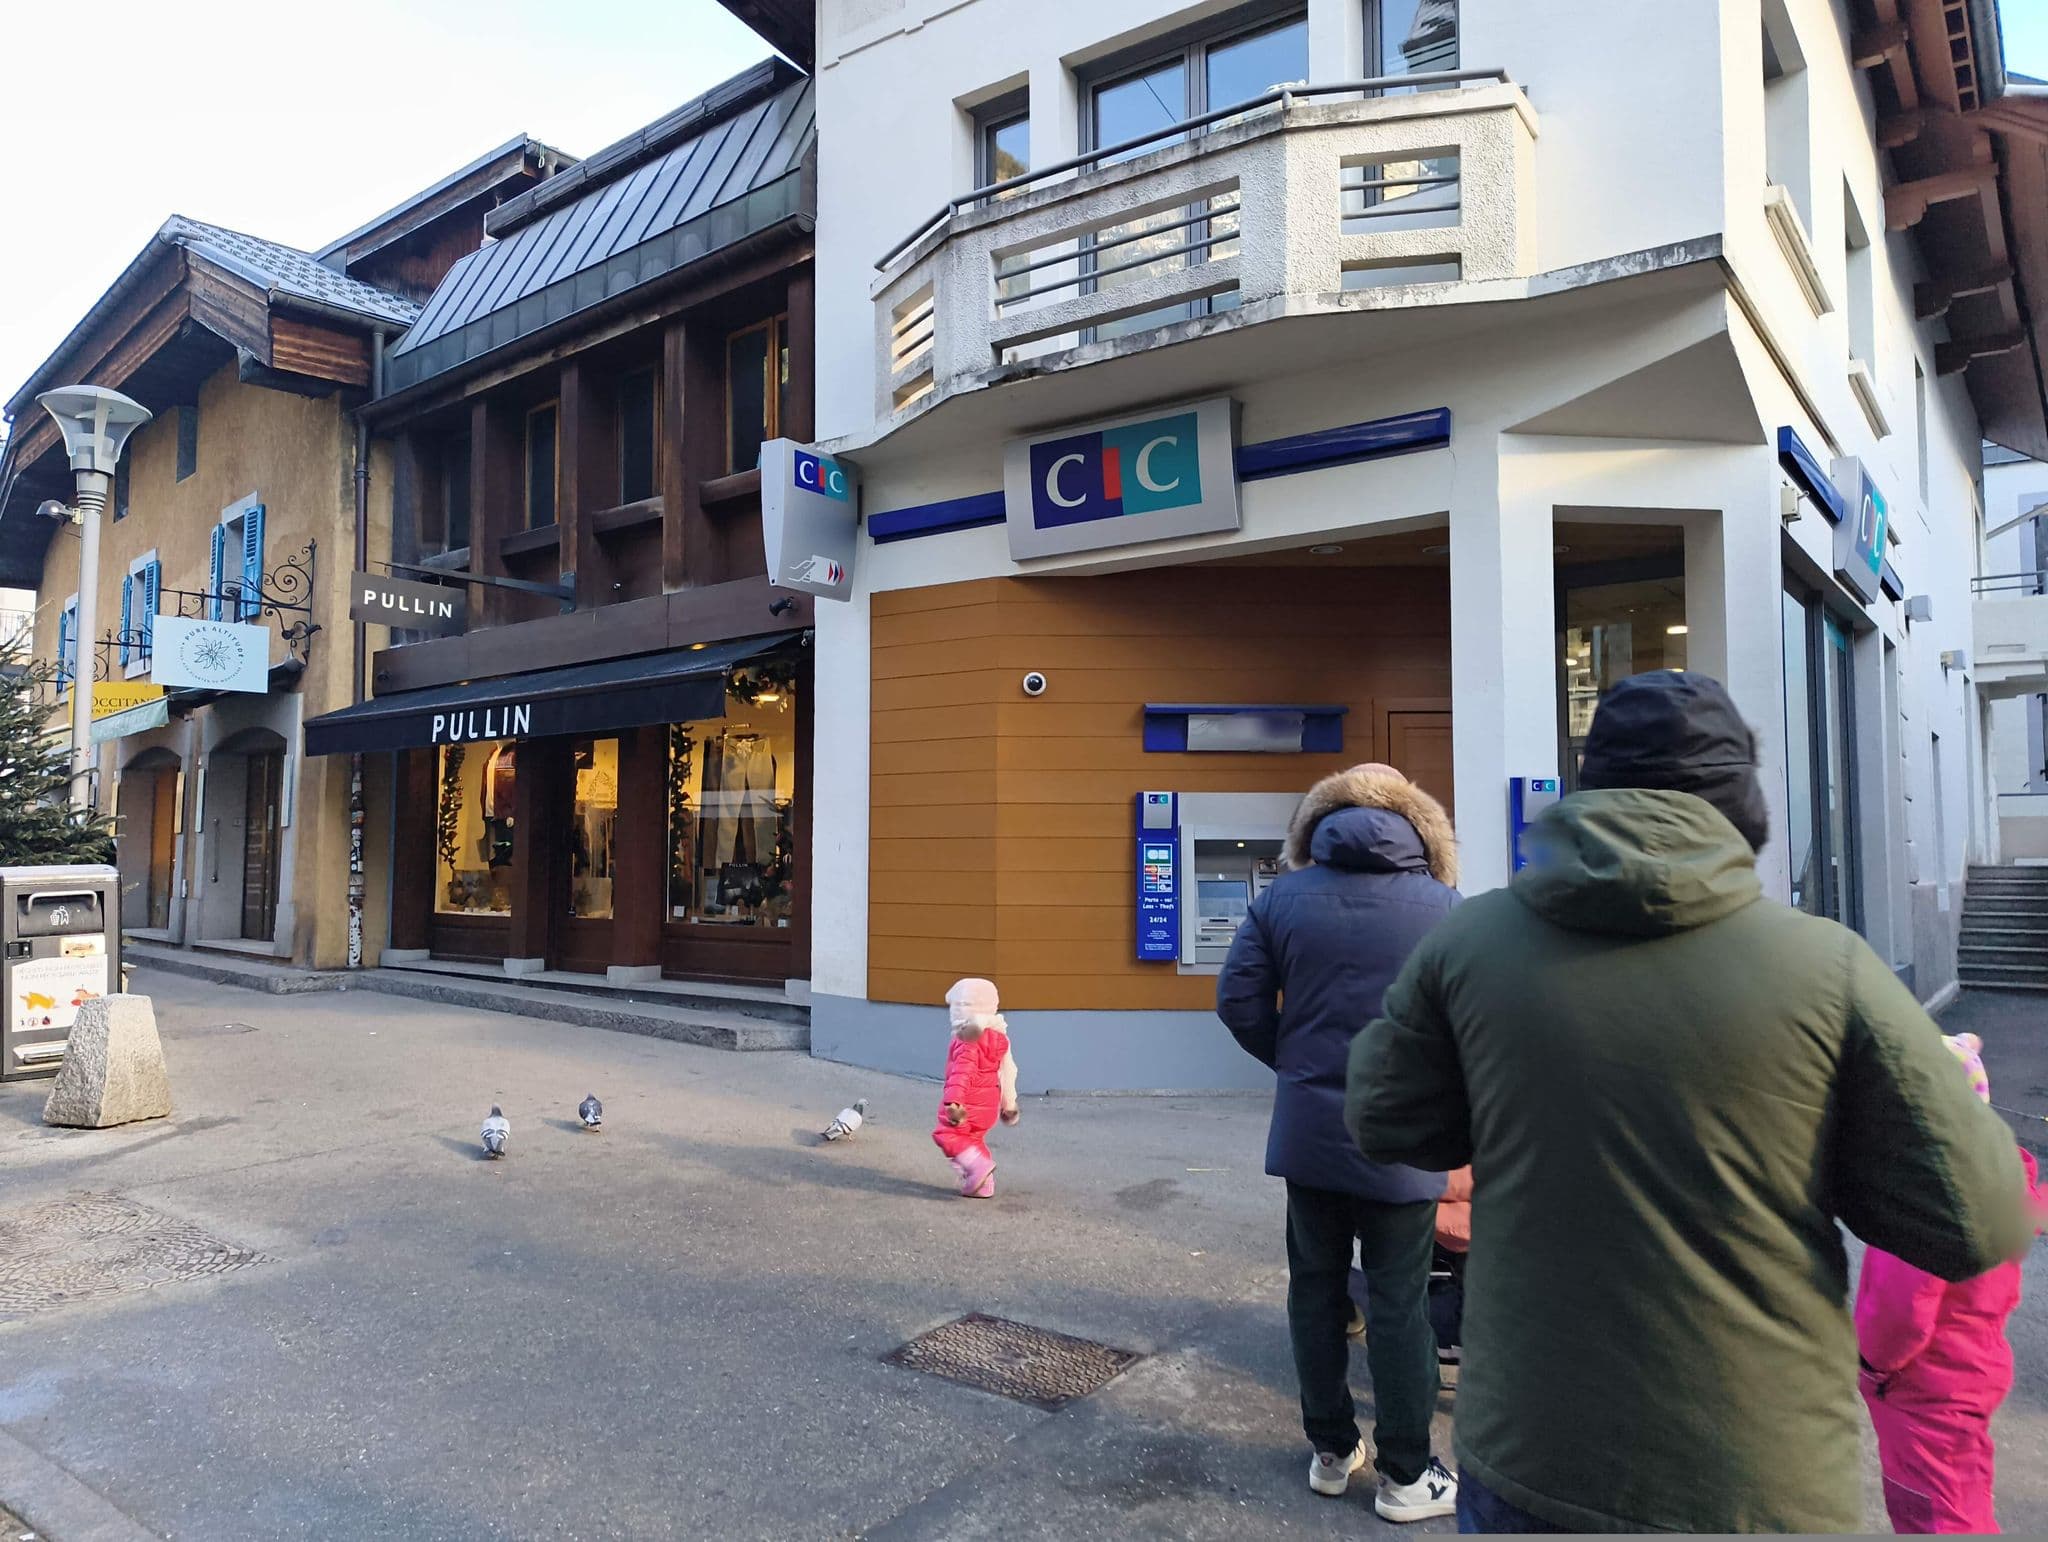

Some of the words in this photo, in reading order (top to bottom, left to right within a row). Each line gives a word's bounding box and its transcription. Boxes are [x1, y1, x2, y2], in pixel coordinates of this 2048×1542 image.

[800, 461, 843, 493] CIC
[1046, 436, 1180, 508] CIC
[364, 589, 453, 618] PULLIN
[185, 626, 207, 641] PURE
[212, 626, 244, 658] ALTITUDE
[92, 697, 155, 707] OCCITAN
[431, 703, 532, 743] PULLIN
